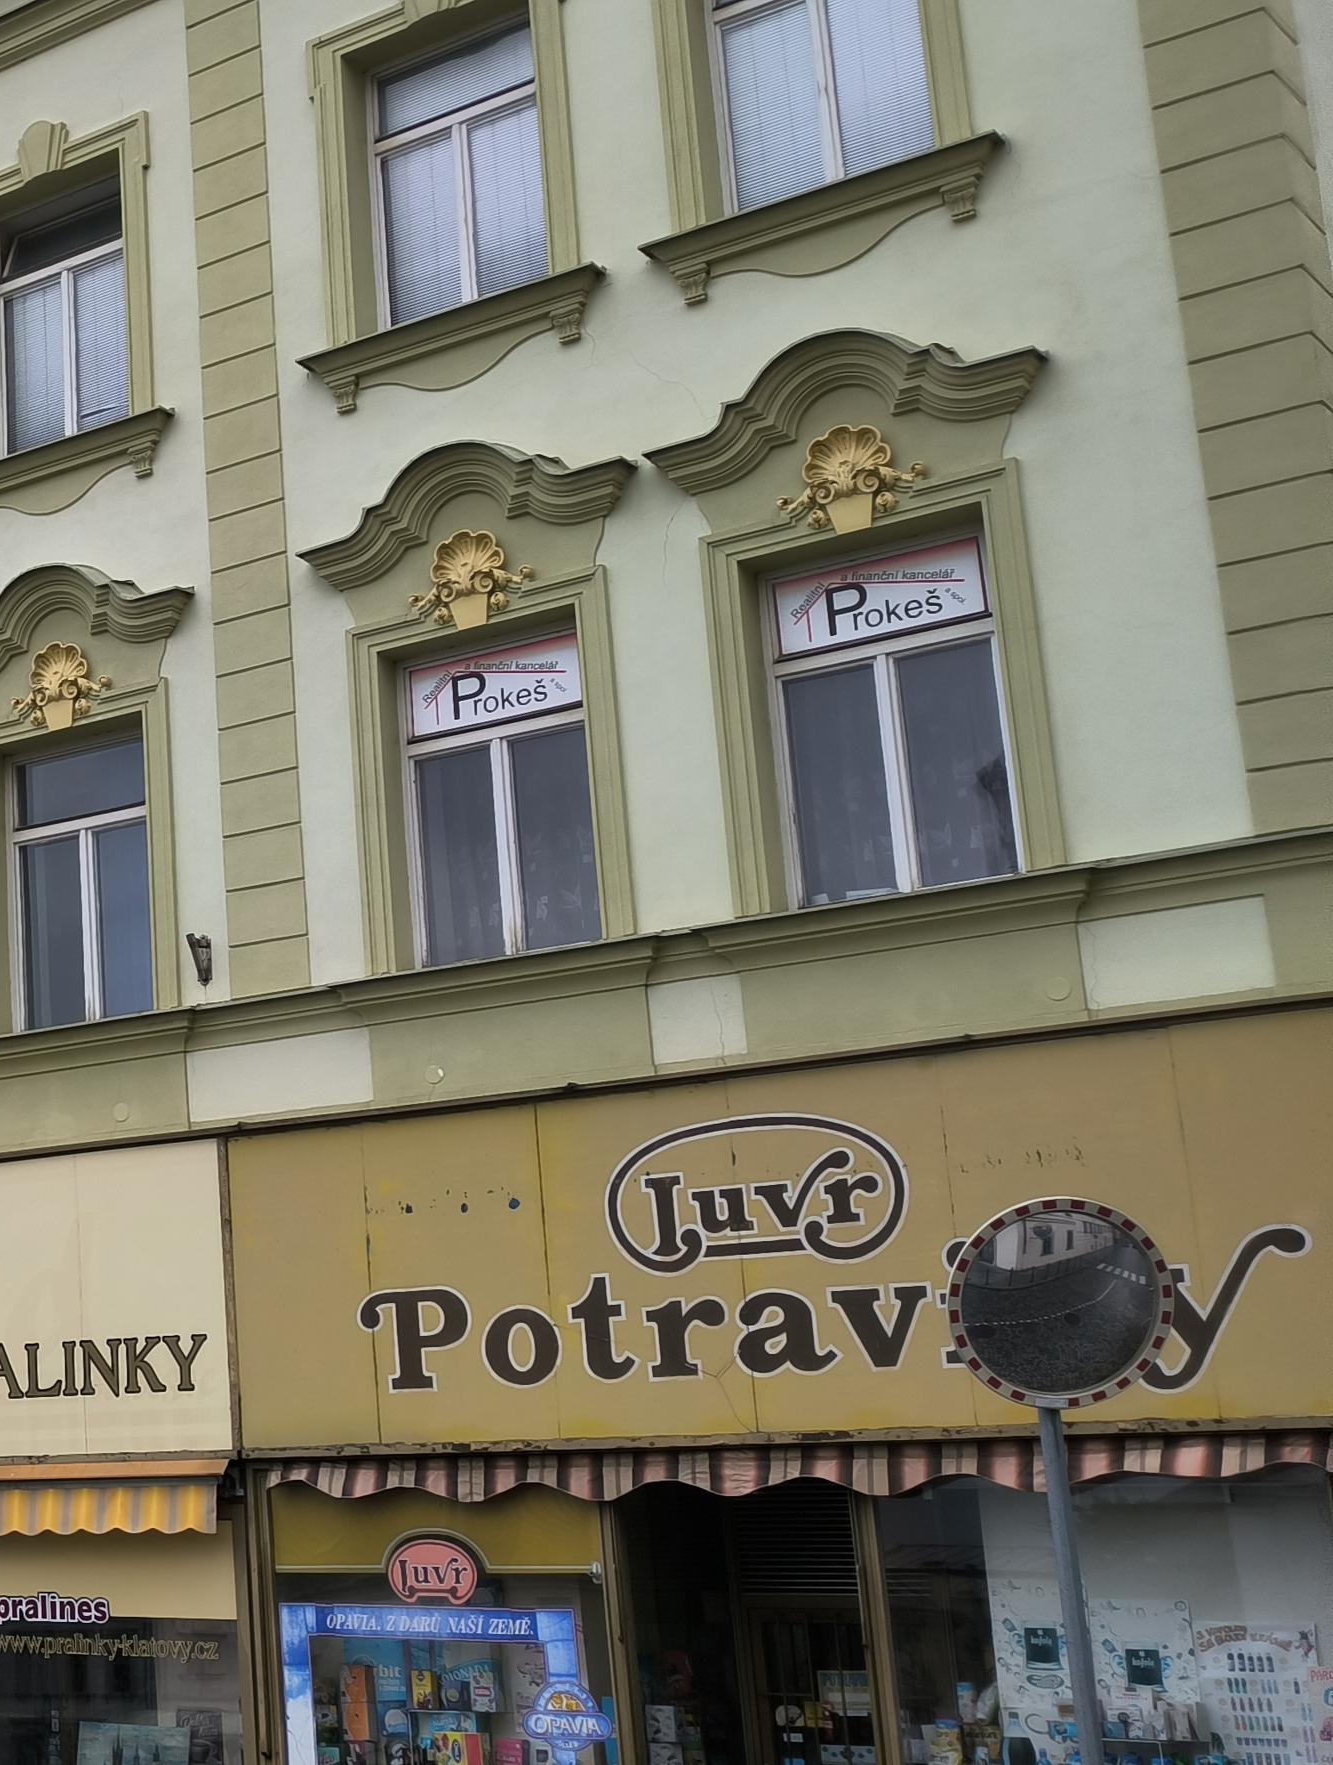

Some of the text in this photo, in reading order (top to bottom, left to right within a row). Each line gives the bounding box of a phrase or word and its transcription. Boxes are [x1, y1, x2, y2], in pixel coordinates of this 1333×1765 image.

[791, 580, 826, 619] Realitní
[851, 569, 899, 582] finanční
[902, 568, 955, 580] kancelář
[825, 583, 943, 637] Prokeš
[421, 669, 452, 703] Realitní
[473, 660, 513, 671] finanční
[515, 660, 559, 670] kancelář
[451, 672, 548, 721] Prokeš
[357, 1224, 1312, 1394] Potravy
[326, 1613, 381, 1631] OPAVIA.
[386, 1616, 396, 1632] Z
[448, 1613, 485, 1635] NAŠÍ
[488, 1616, 535, 1637] ZEMĚ.
[532, 1714, 603, 1736] OPAVIA
